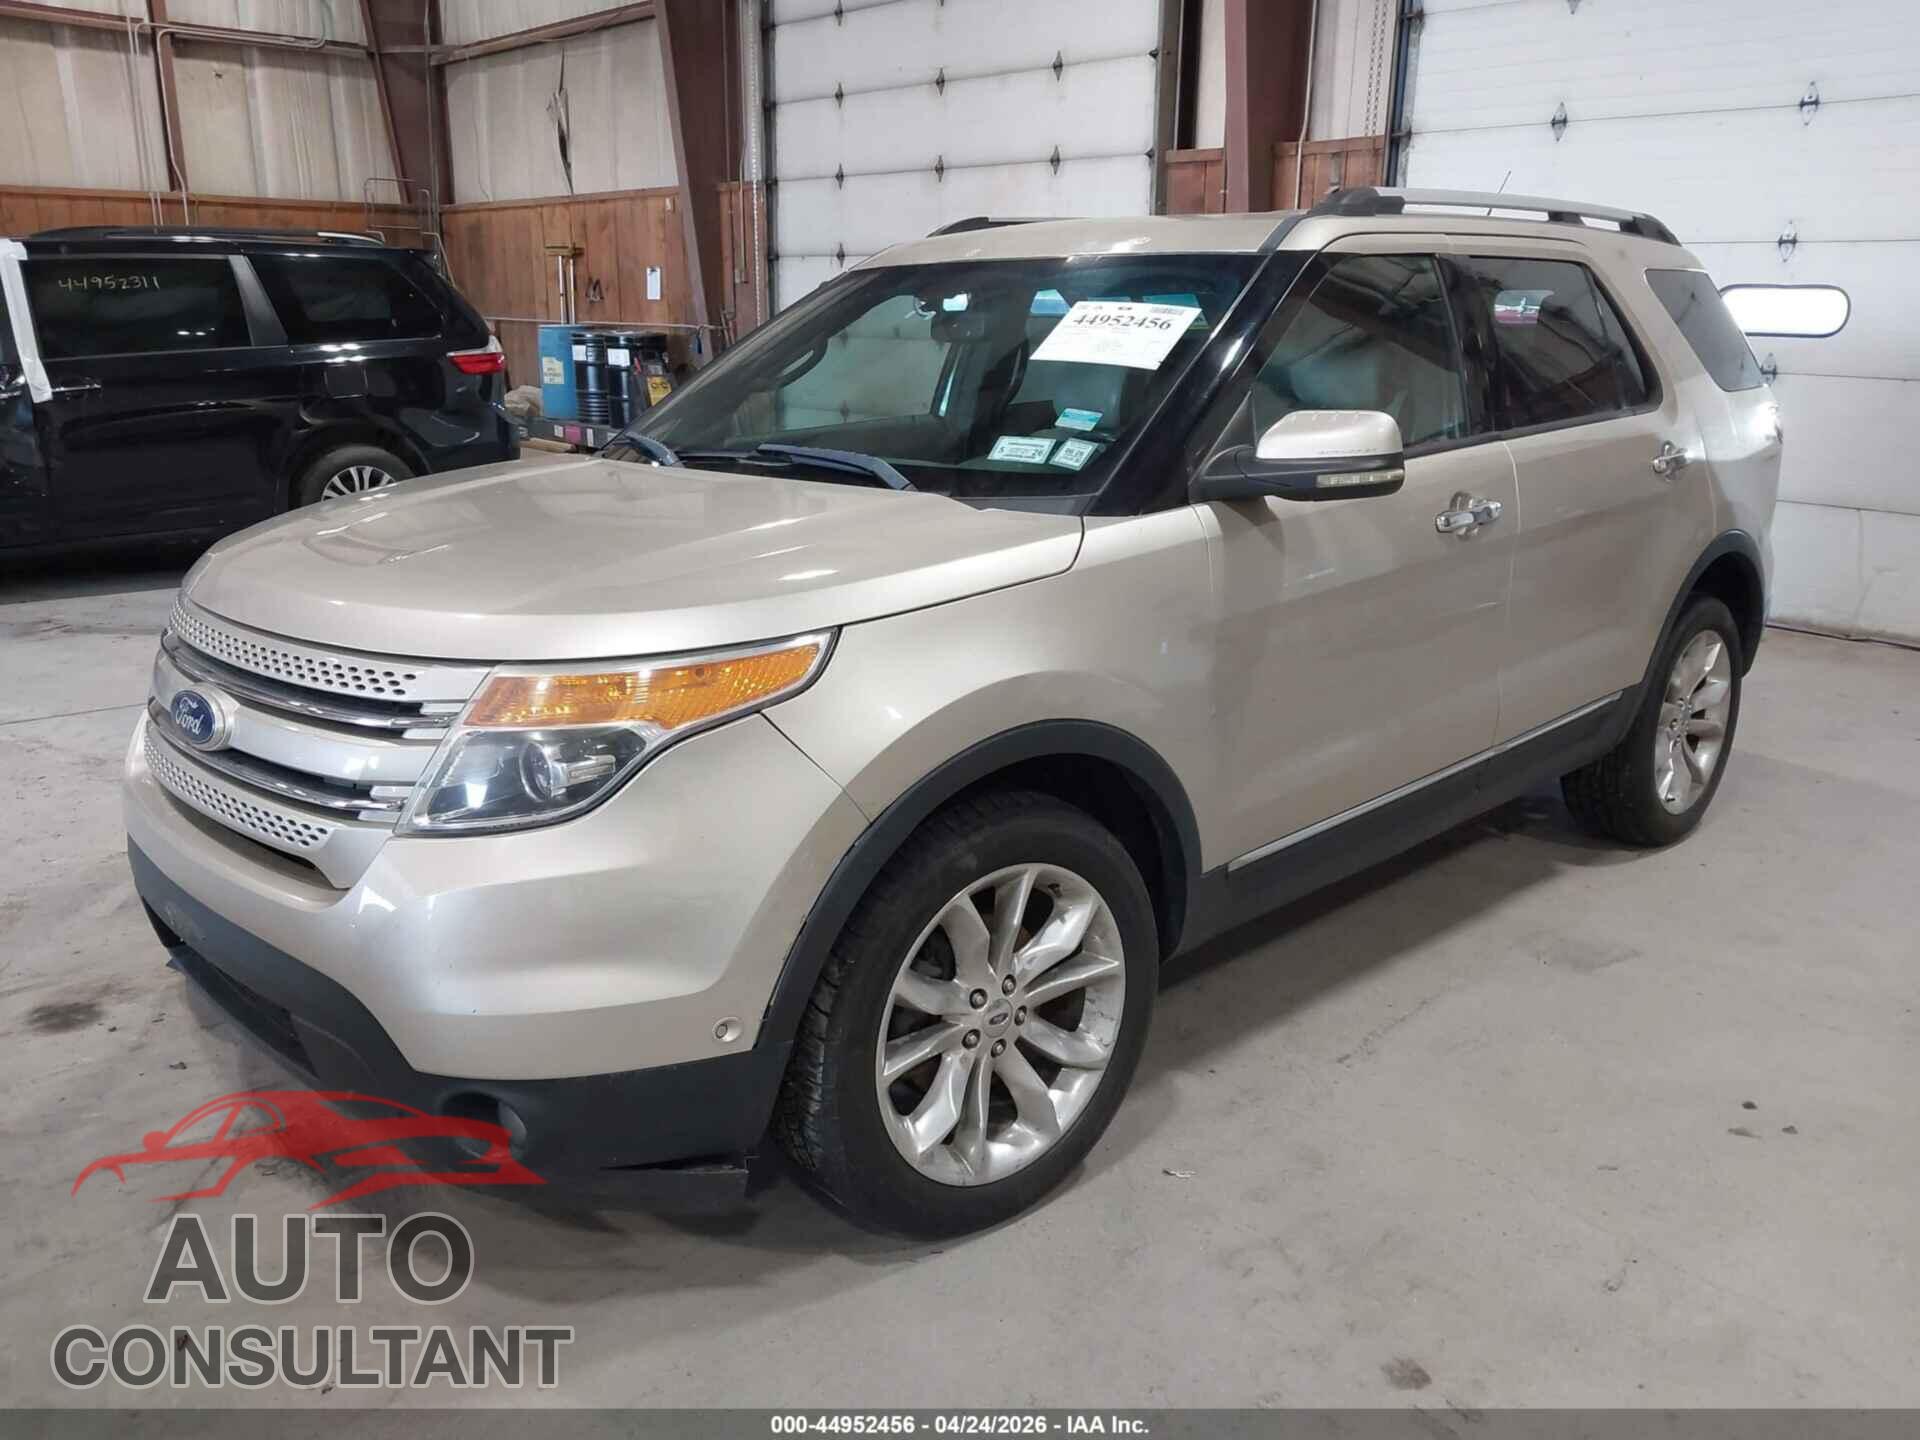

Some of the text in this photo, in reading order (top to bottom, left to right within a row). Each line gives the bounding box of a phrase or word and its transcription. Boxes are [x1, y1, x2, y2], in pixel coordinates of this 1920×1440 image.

[58, 274, 160, 291] 44952311
[1072, 313, 1172, 330] 44952456
[175, 697, 205, 735] Ford
